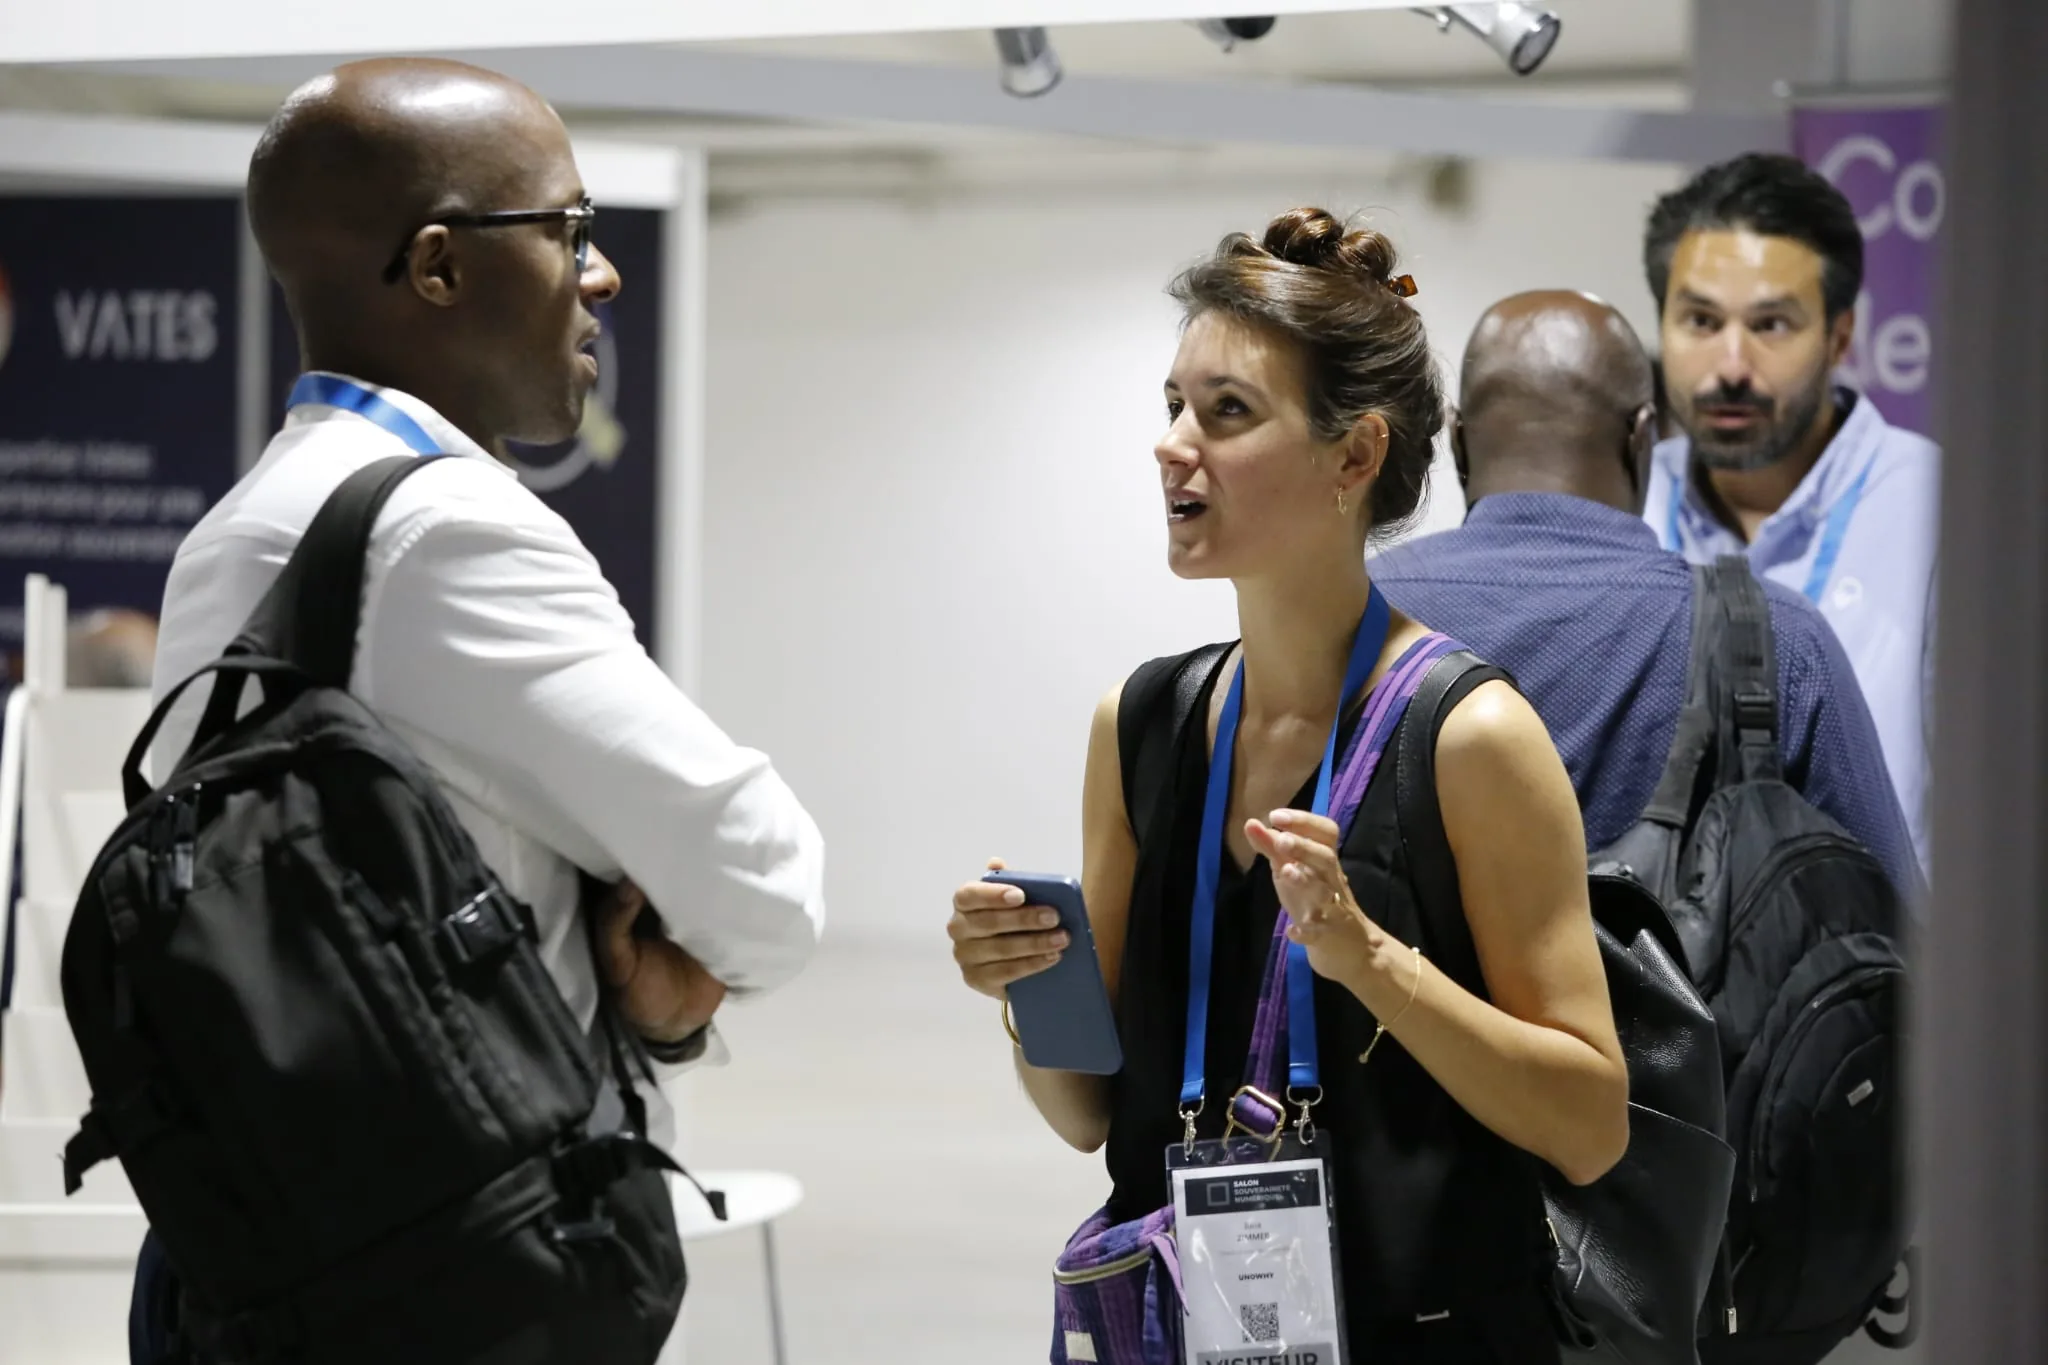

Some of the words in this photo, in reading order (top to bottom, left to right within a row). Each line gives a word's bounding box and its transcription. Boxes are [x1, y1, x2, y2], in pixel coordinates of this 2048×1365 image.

[55, 289, 218, 362] VATES
[1233, 1179, 1260, 1188] SALON
[1238, 1272, 1274, 1281] UNOWHY
[1205, 1352, 1319, 1365] ITEUR
